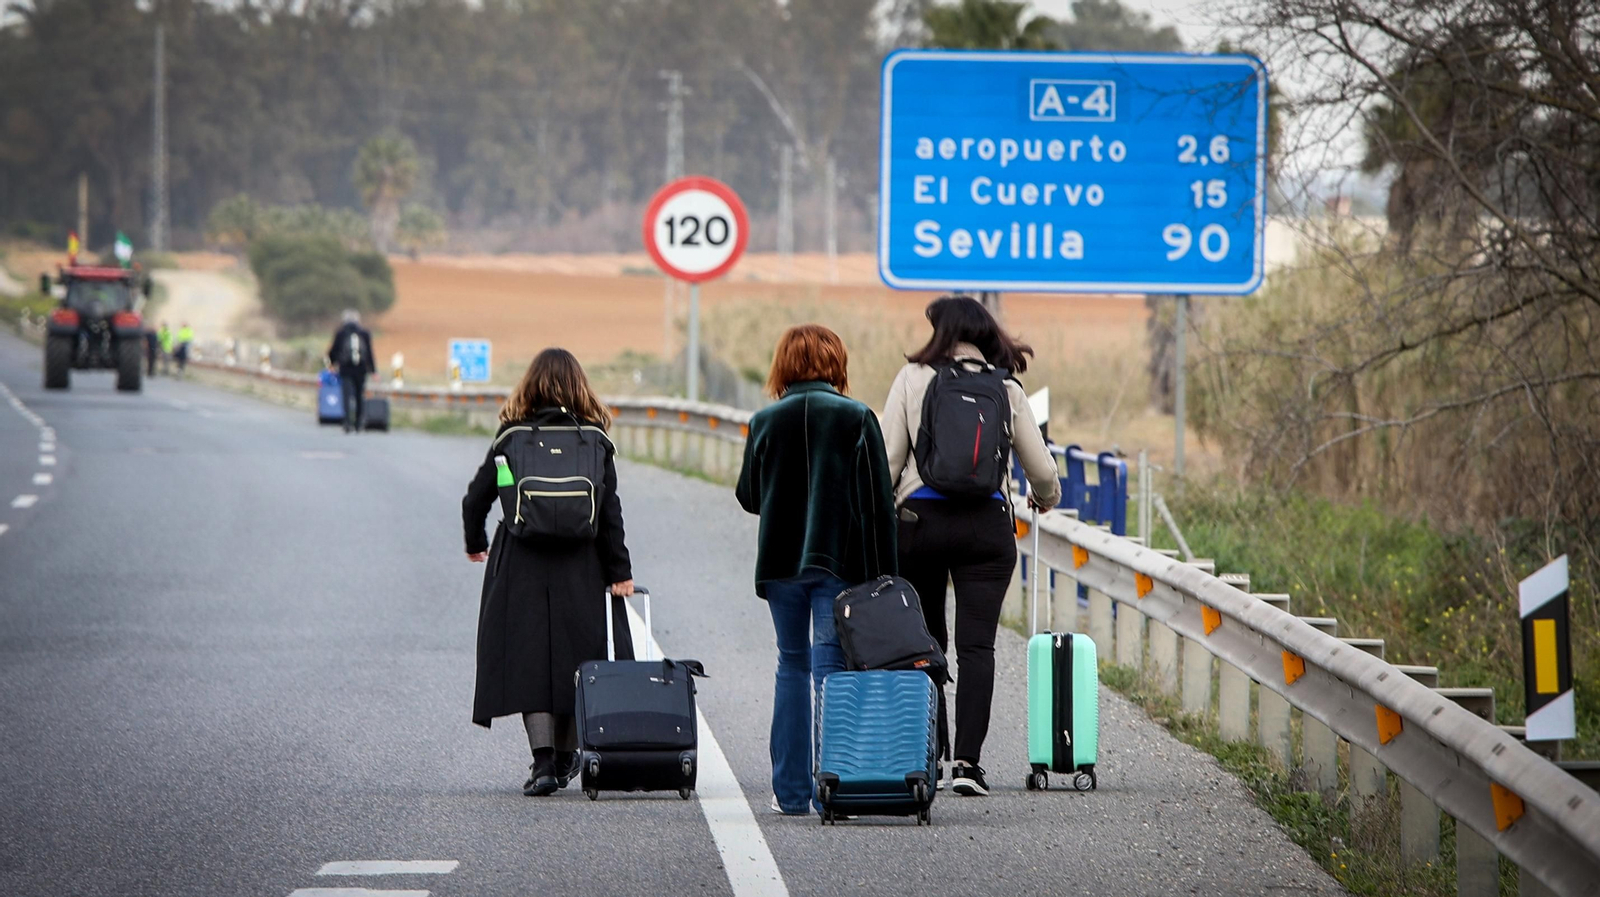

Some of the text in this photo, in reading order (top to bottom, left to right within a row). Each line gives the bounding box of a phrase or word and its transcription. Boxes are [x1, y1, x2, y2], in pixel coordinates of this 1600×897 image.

[1036, 85, 1110, 116] A-4
[914, 134, 1231, 168] aeropuerto 2,6
[914, 174, 1228, 209] El Cuervo 15
[664, 215, 730, 247] 120
[913, 219, 1231, 263] Sevilla 90
